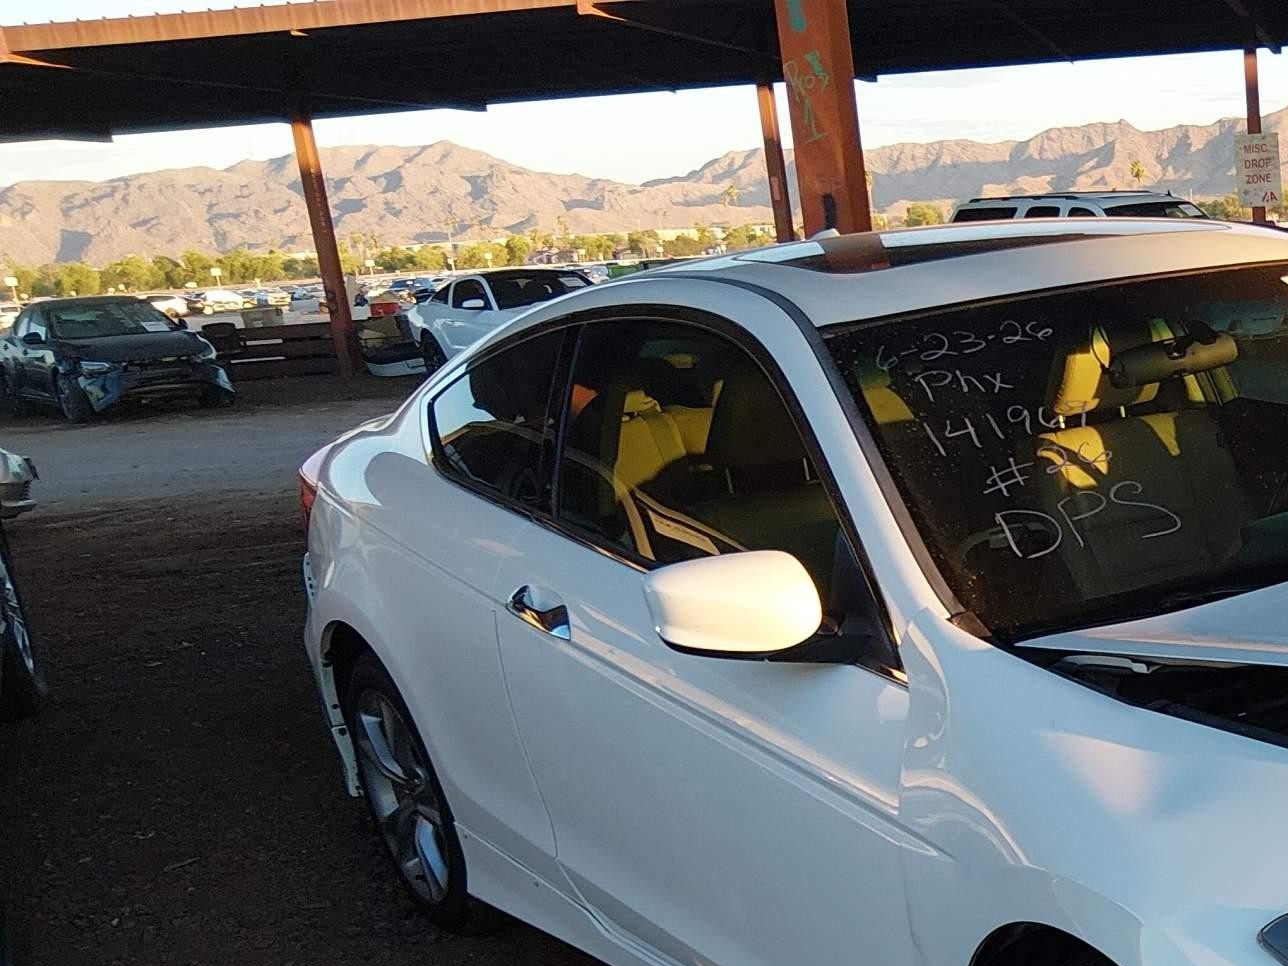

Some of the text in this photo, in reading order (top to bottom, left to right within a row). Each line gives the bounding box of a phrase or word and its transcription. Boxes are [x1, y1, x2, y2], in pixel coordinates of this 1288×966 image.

[1243, 144, 1268, 154] MISC
[1244, 158, 1272, 169] DROP
[1246, 173, 1272, 185] ZONE
[876, 320, 1053, 370] 6-23-26
[995, 480, 1182, 559] DPS
